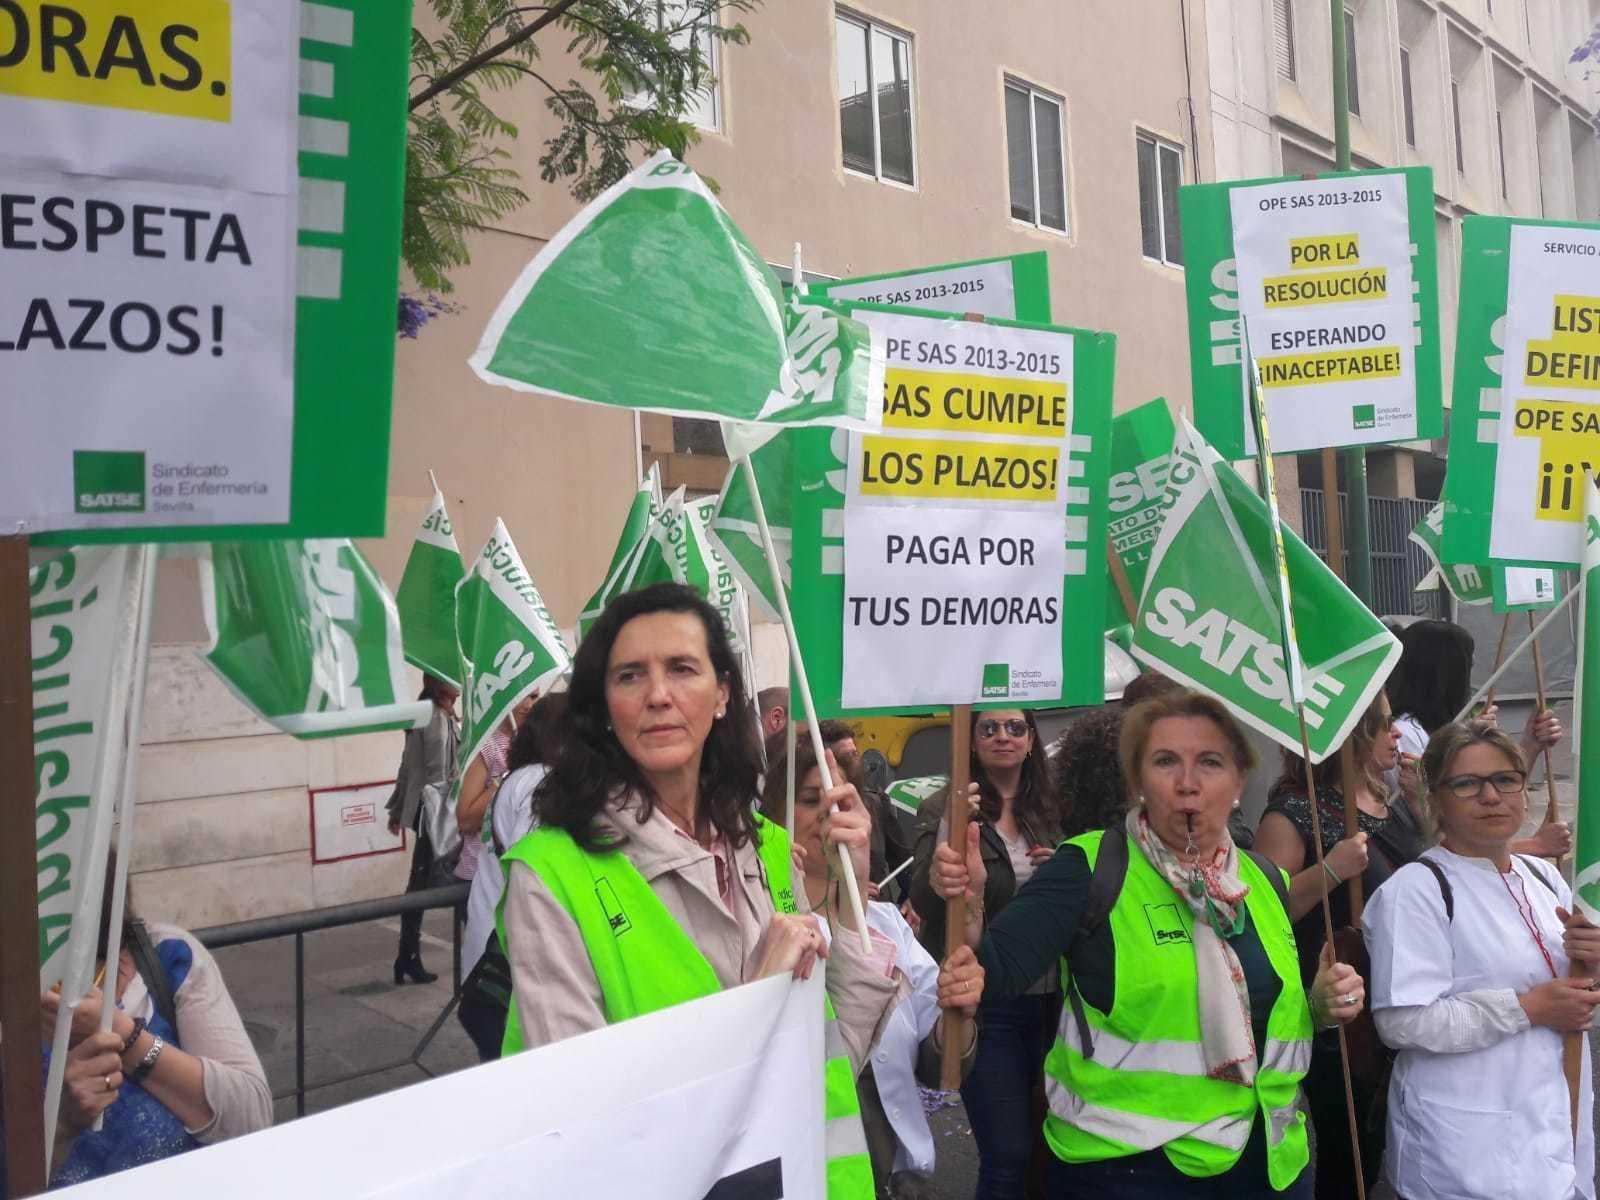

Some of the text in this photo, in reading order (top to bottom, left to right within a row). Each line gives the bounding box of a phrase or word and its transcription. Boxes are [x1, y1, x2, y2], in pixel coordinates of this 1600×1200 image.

[1259, 190, 1382, 211] OPE SAS 2013-2015
[1, 194, 252, 266] ESPETA
[1291, 241, 1360, 264] POR LA
[1544, 242, 1596, 255] SERVICIO
[887, 291, 912, 305] SAS
[916, 279, 985, 301] 2013-2015
[1264, 271, 1387, 303] RESOLUCIÓN
[1271, 323, 1386, 350] ESPERANDO
[917, 342, 957, 364] SAS
[964, 345, 1060, 375] 2013-2015
[943, 387, 1066, 427] CUMPLE
[1515, 408, 1564, 431] OPE
[153, 464, 228, 479] Sindicato
[863, 451, 1057, 491] LOS PLAZOS!
[79, 493, 142, 508] SATSE
[152, 481, 174, 497] de
[886, 535, 1034, 566] PAGA POR
[849, 597, 1058, 626] TUS DEMORAS
[1145, 587, 1345, 730] SATSE
